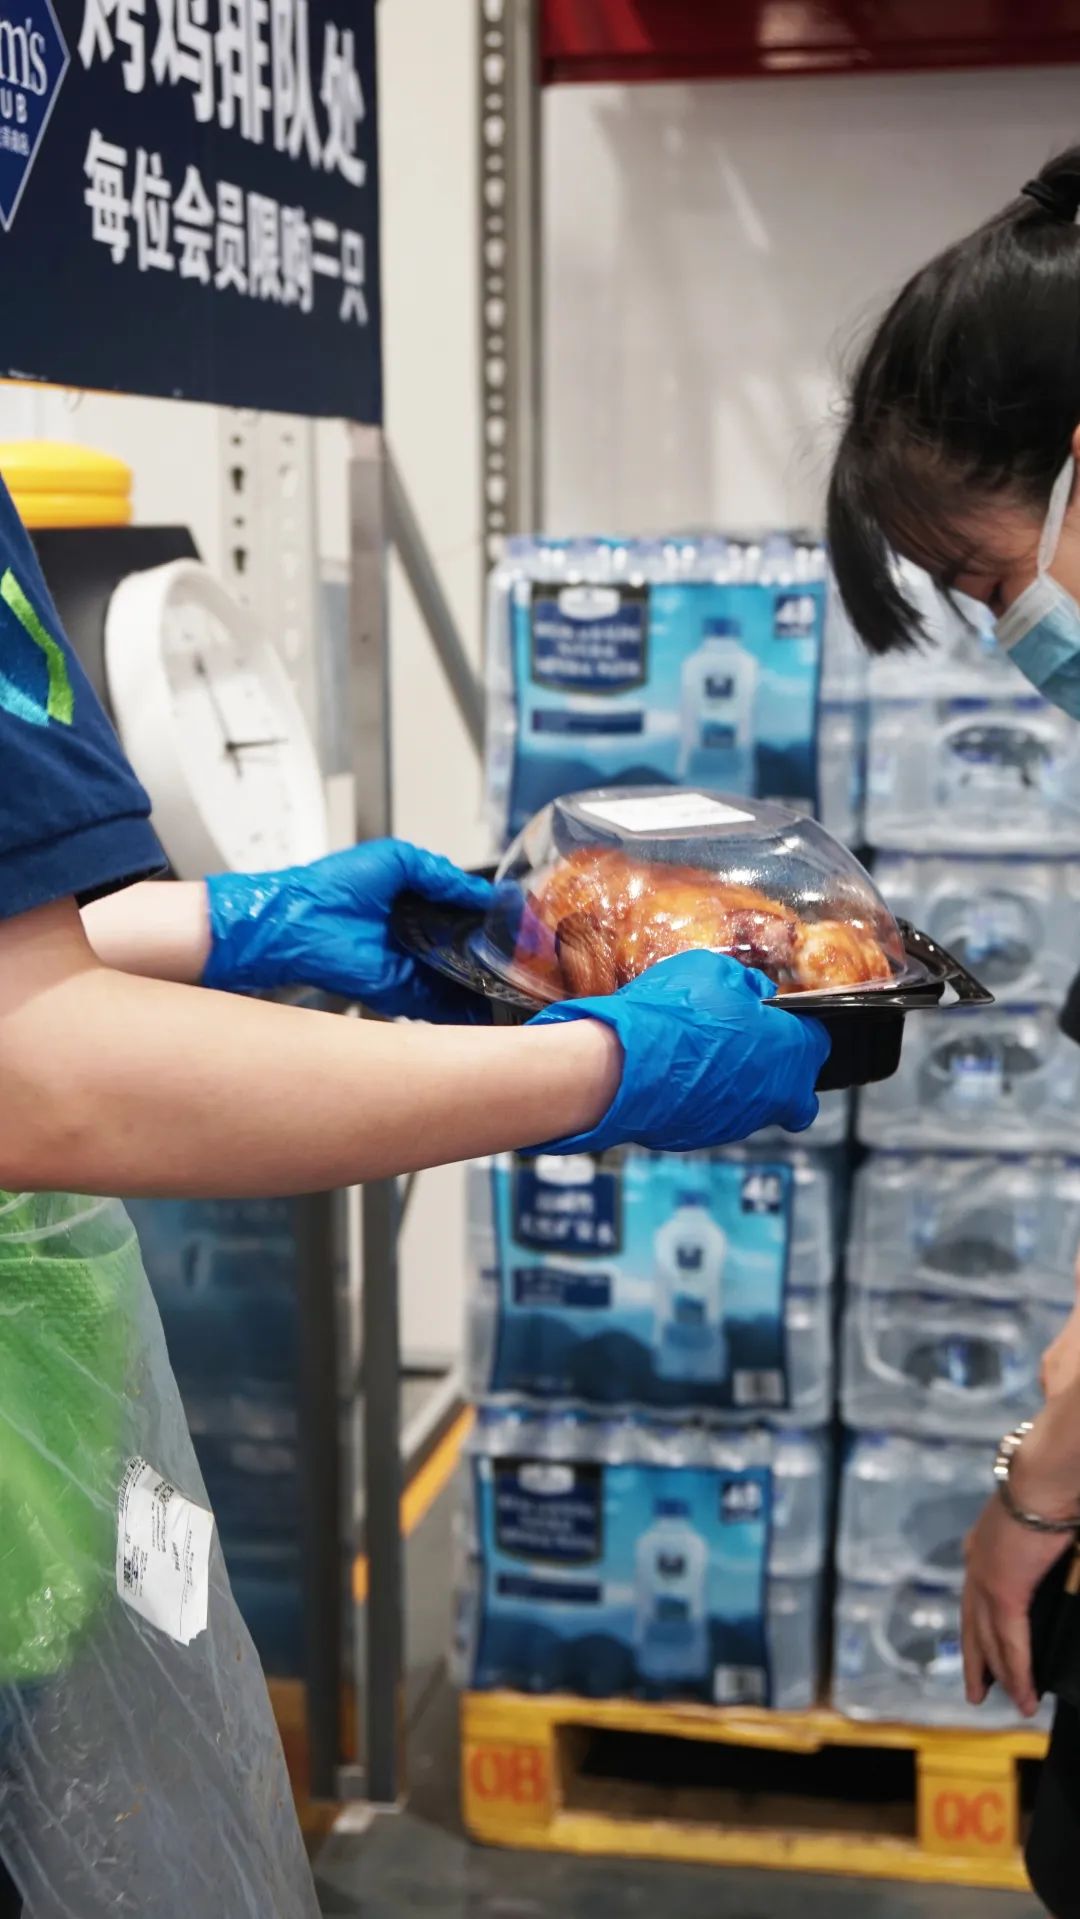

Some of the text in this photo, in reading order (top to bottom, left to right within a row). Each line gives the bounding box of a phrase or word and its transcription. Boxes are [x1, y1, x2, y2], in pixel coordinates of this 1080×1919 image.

[84, 127, 368, 326] 每位会员限购二只
